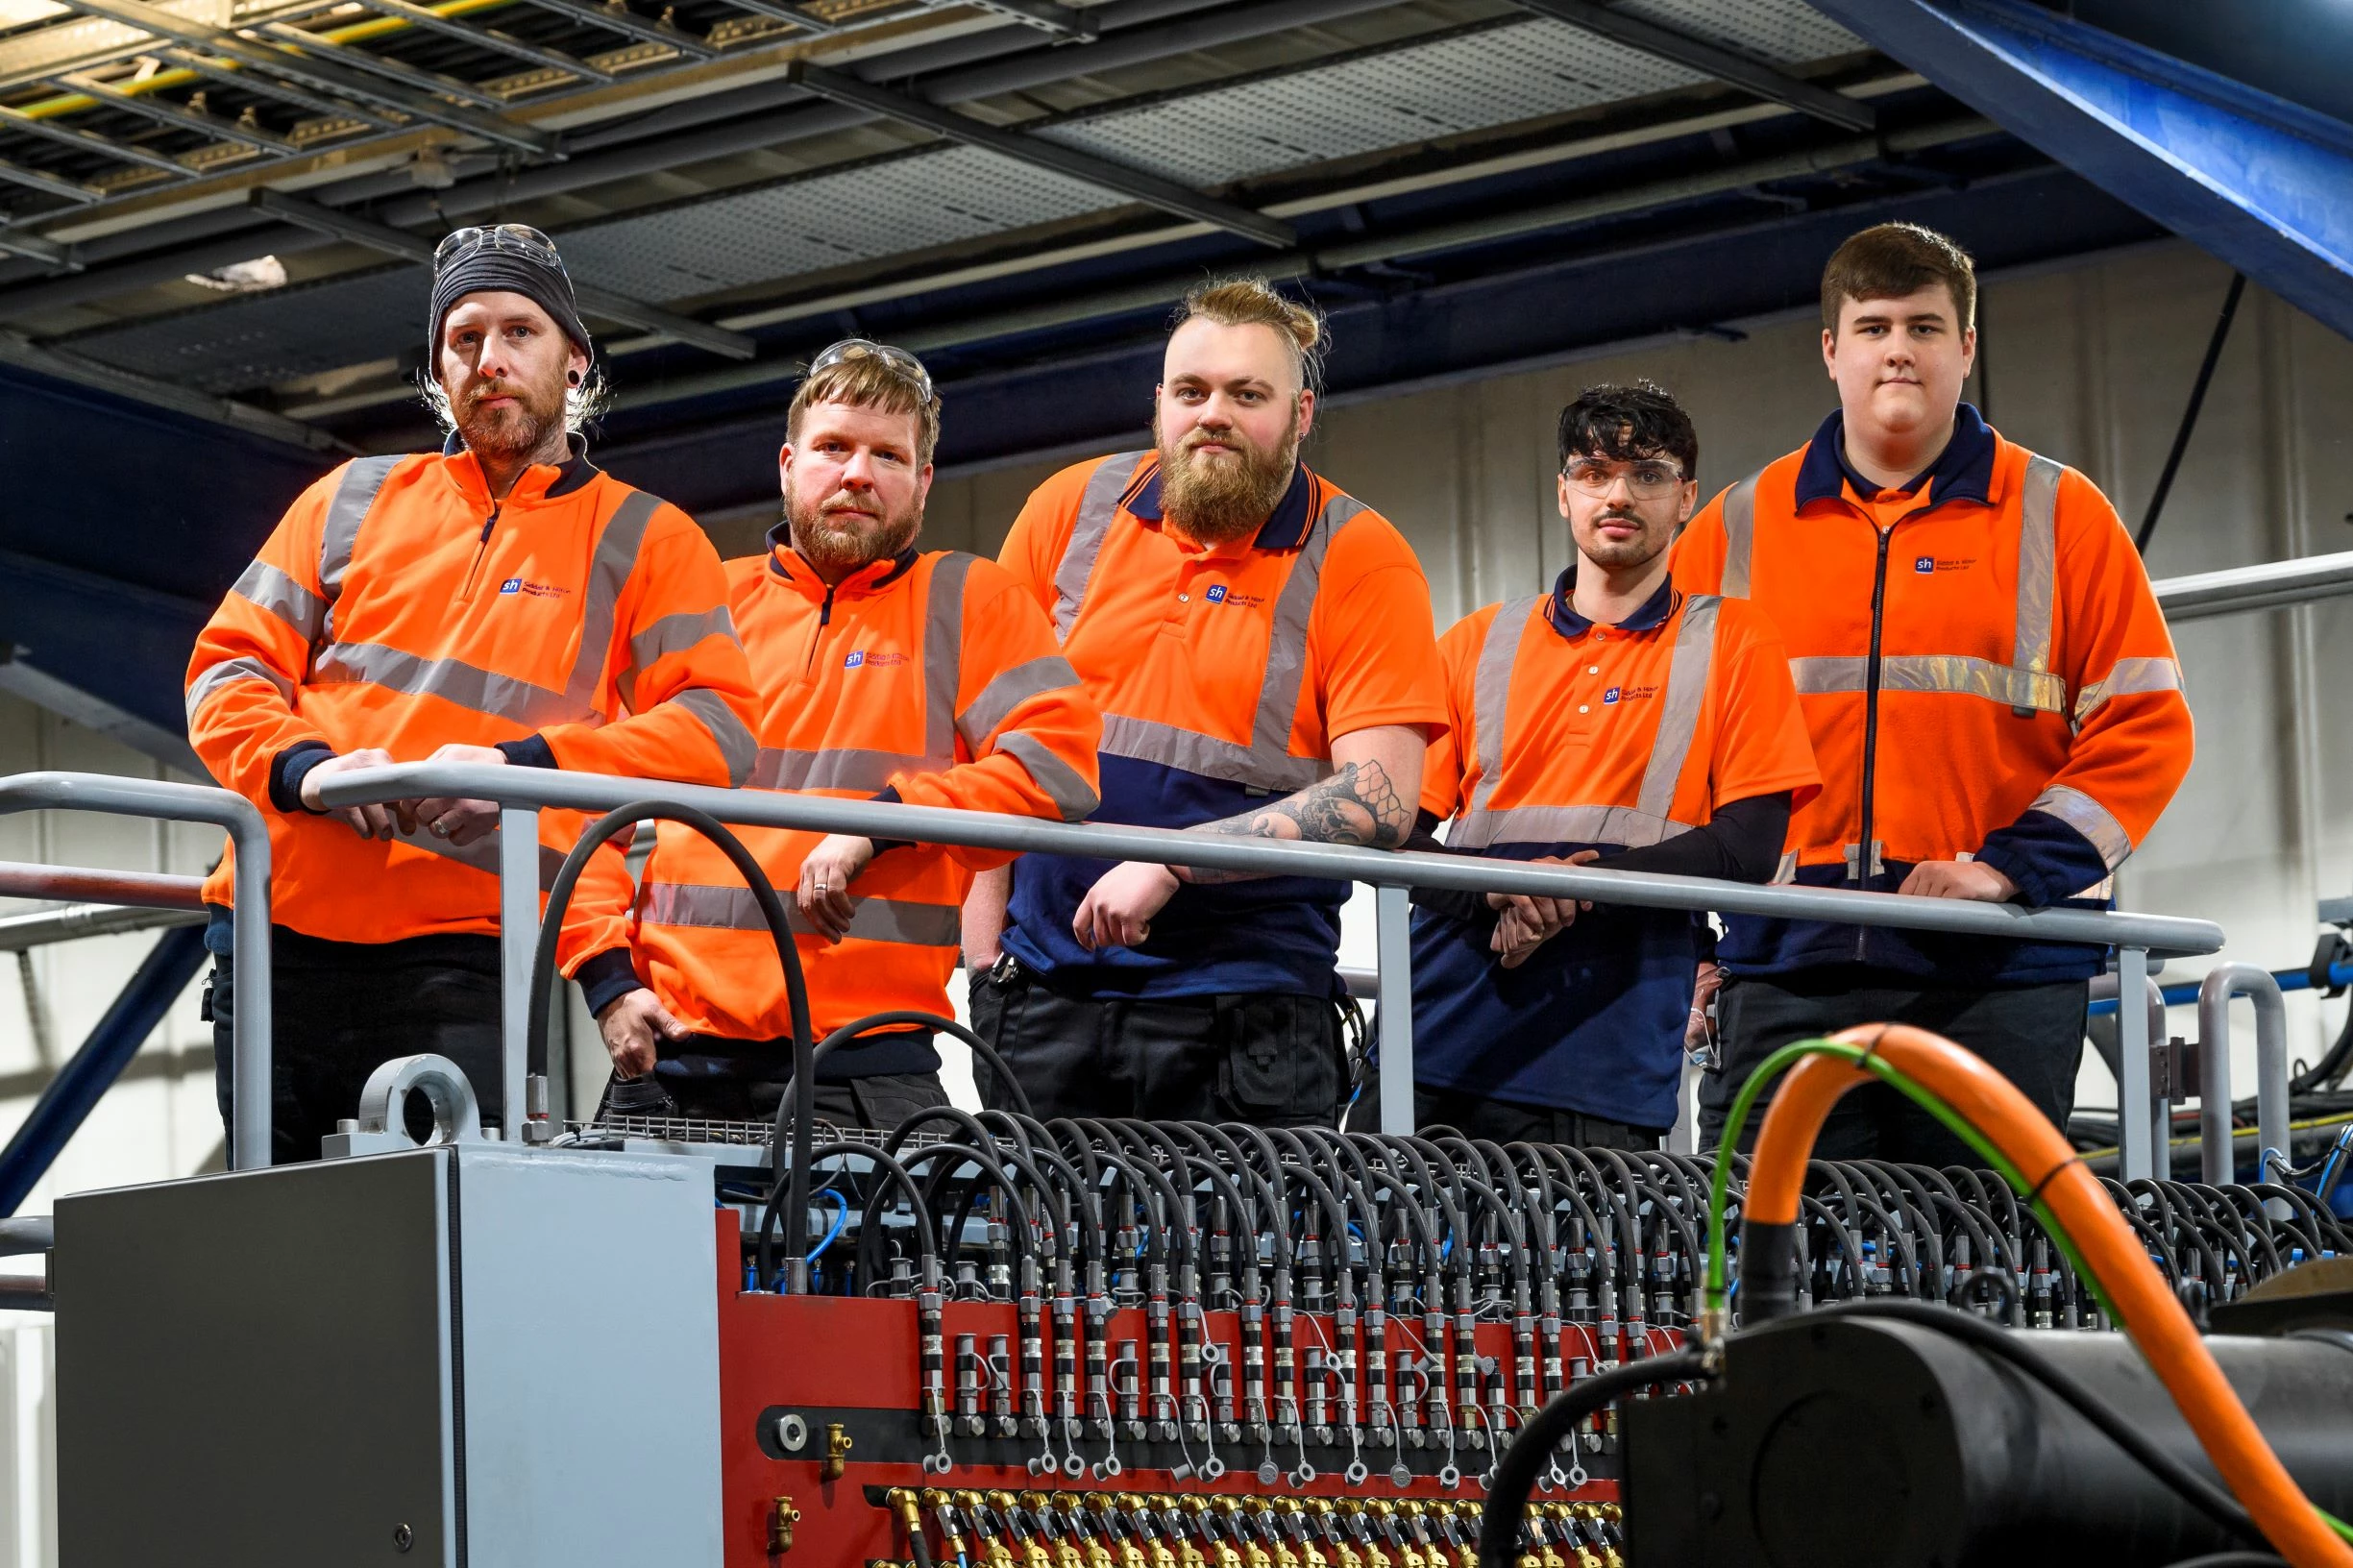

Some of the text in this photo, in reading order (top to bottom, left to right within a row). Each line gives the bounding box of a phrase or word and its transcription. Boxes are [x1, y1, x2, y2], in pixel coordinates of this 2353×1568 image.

[1918, 558, 1932, 569] sh
[502, 579, 519, 590] sh
[1209, 586, 1223, 599] sh
[846, 652, 861, 665] sh
[1605, 688, 1618, 700] sh
